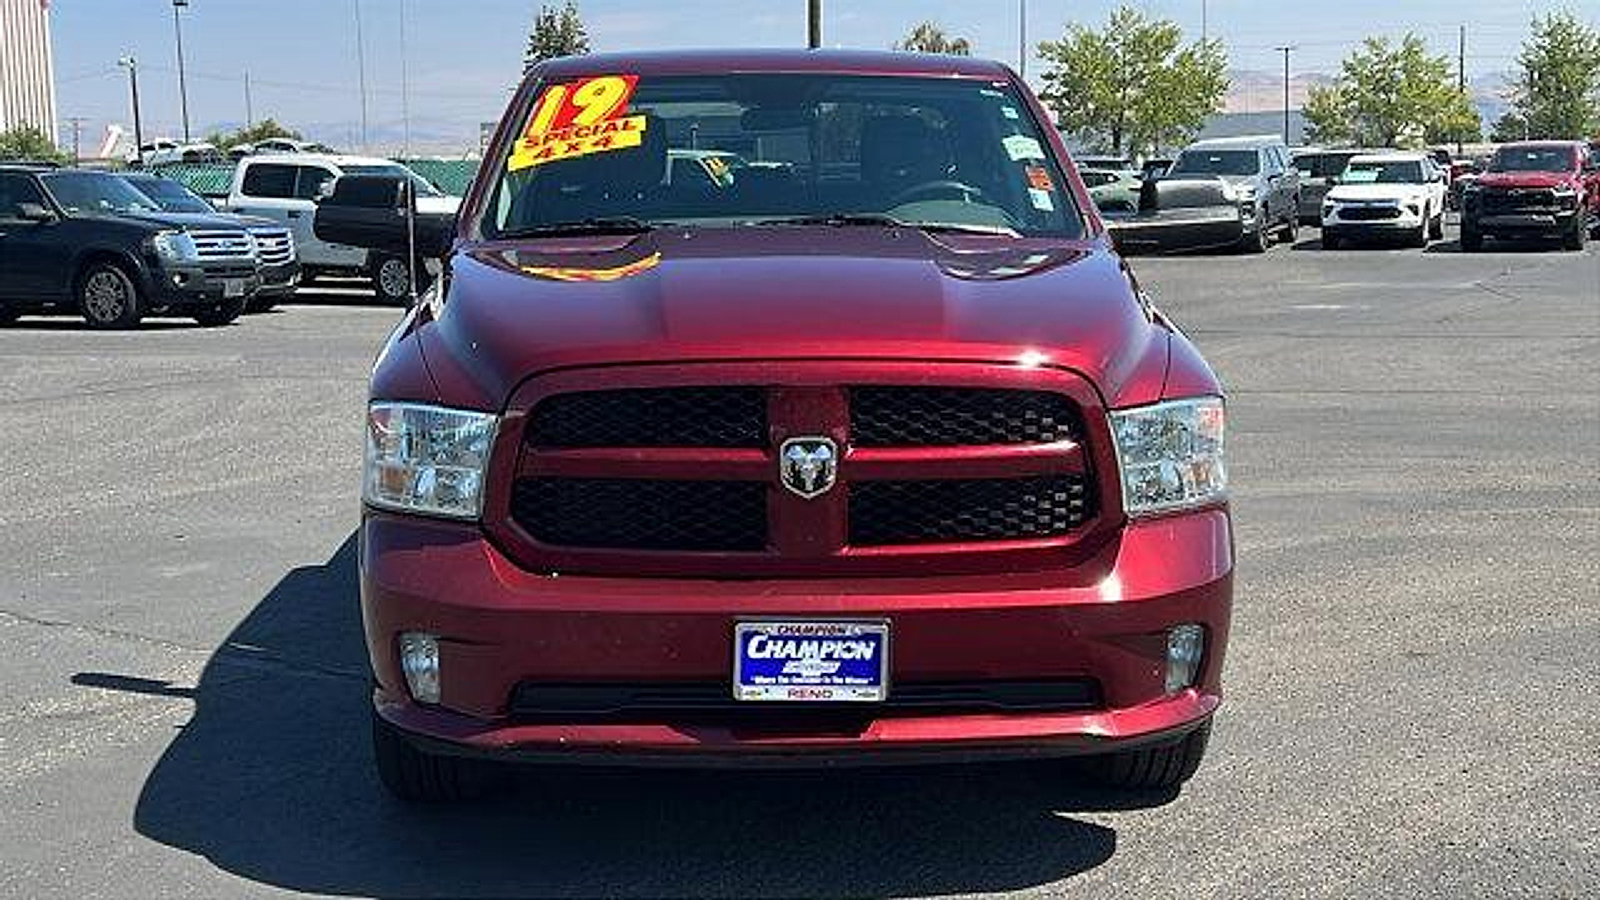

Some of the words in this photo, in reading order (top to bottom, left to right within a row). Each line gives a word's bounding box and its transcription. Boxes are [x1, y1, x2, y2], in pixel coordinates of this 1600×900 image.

[527, 76, 627, 137] 19
[523, 119, 637, 148] SPECIAL
[533, 146, 553, 160] 4
[592, 135, 613, 149] 4
[778, 625, 841, 635] CHAMPION
[787, 688, 834, 699] RENO
